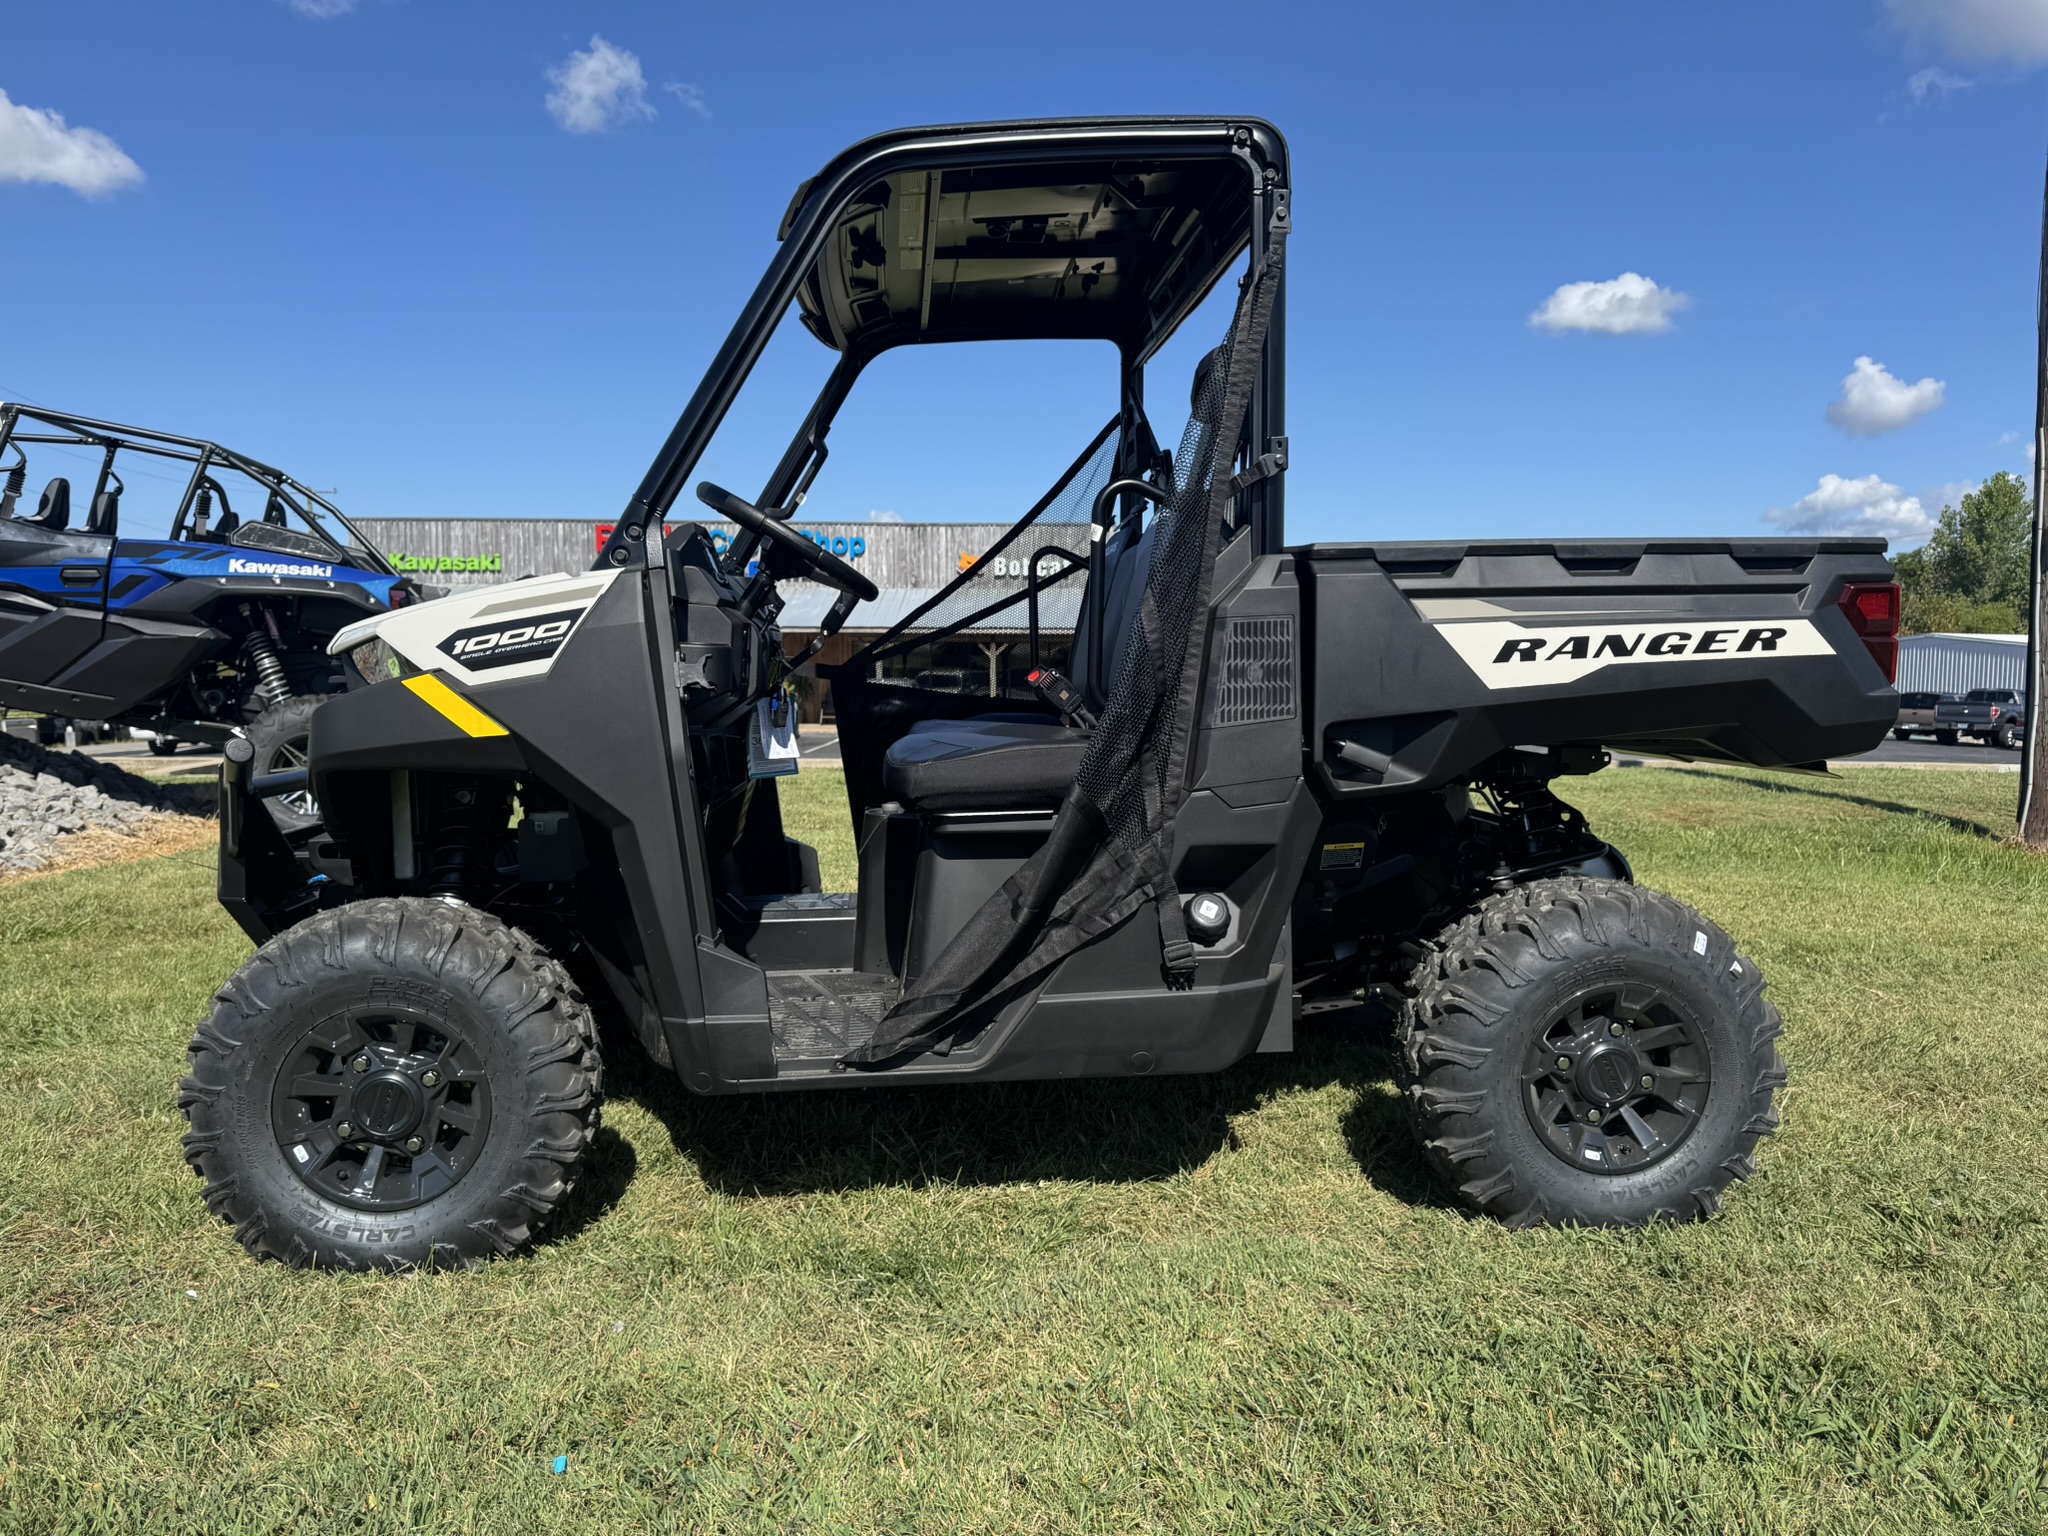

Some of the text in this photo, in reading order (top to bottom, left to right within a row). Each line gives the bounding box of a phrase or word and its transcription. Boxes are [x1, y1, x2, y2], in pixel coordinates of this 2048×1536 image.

[228, 559, 332, 577] Kawasaki
[388, 553, 501, 572] Kawasaki
[451, 620, 571, 655] 1000
[460, 637, 563, 660] SINGLE OVERHEAD CAM
[1492, 628, 1787, 663] RANGER
[288, 1203, 416, 1244] CARLSTAR
